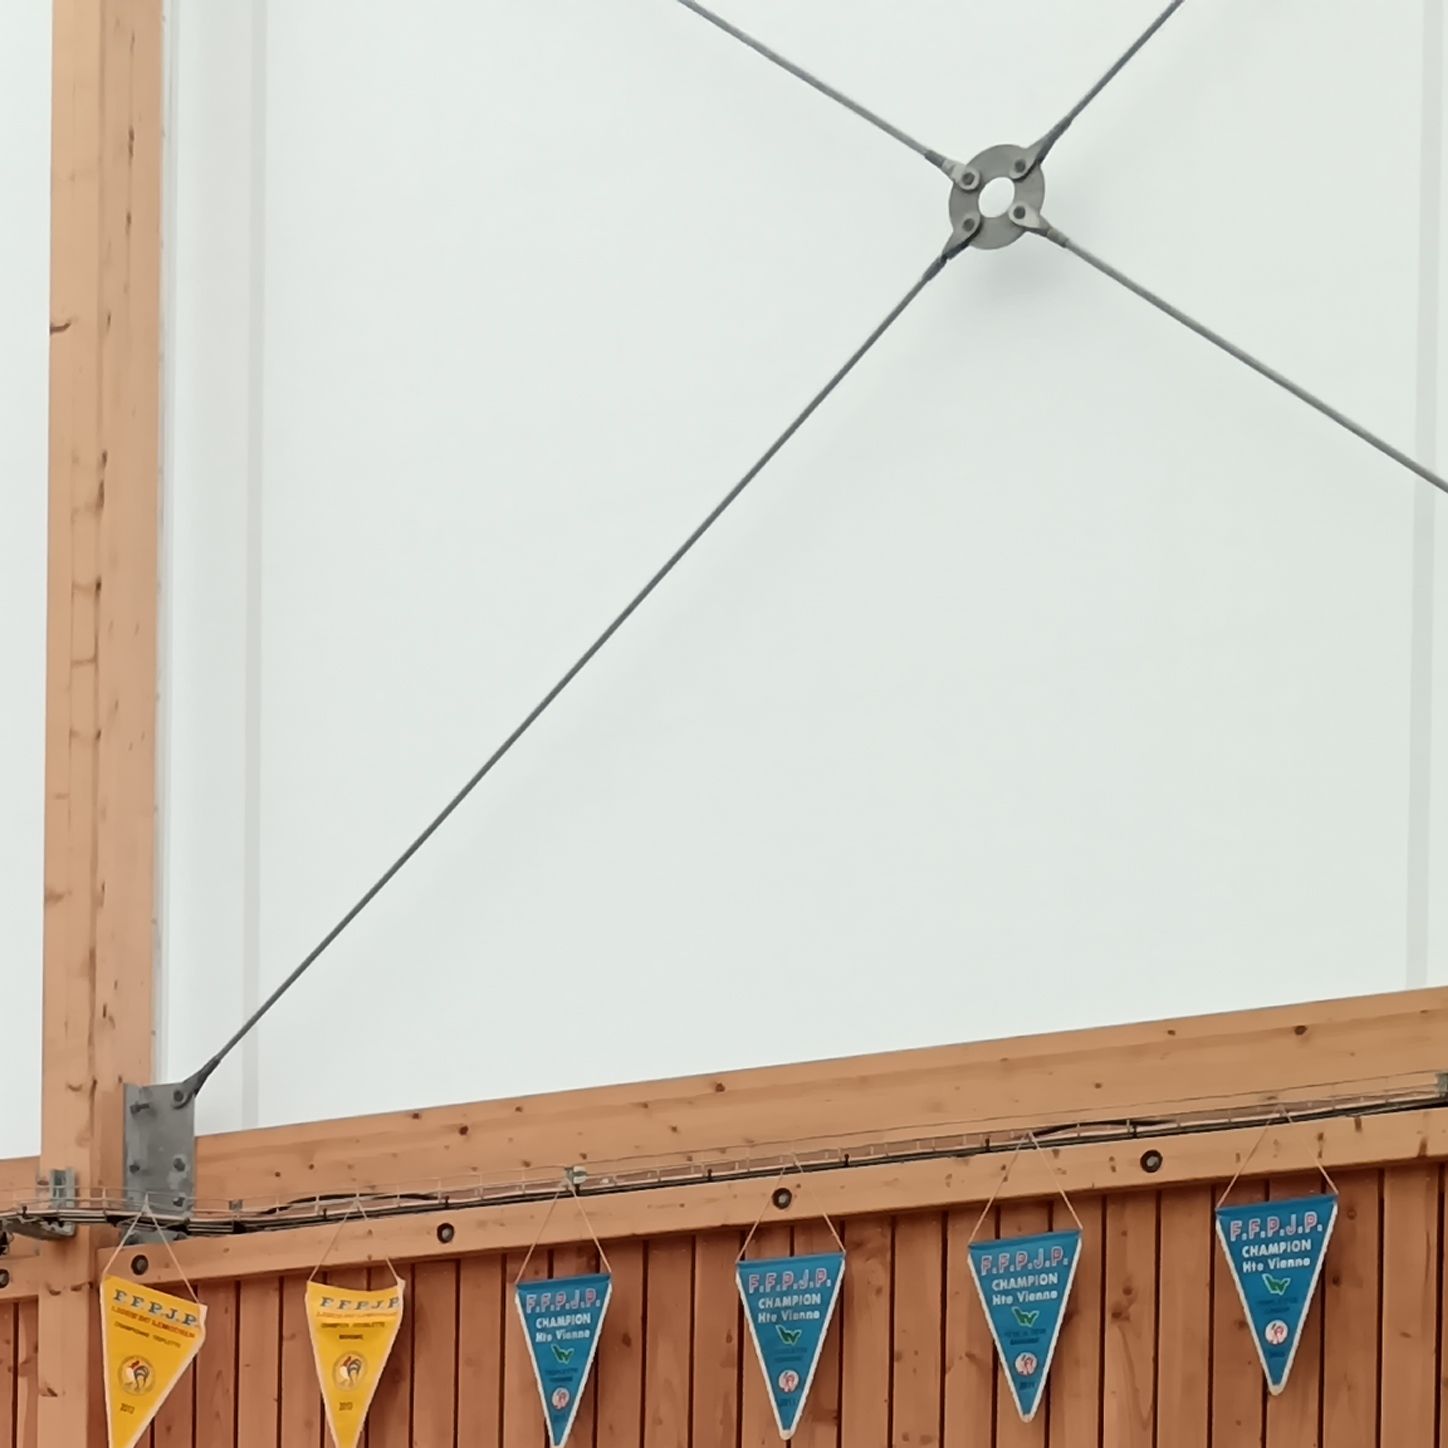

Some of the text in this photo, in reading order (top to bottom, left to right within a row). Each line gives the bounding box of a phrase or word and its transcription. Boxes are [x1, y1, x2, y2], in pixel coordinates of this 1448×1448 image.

[1230, 1211, 1323, 1242] F.F.P.J.P.
[1241, 1239, 1312, 1258] CHAMPION
[981, 1246, 1068, 1276] F.F.P.J.P.
[1268, 1257, 1311, 1270] Vienne
[748, 1267, 832, 1293] F.F.P.J.P.
[992, 1272, 1058, 1291] CHAMPION
[526, 1288, 600, 1314] F.F.P.J.P.
[758, 1293, 821, 1309] CHAMPION
[1017, 1290, 1058, 1303] Vienne
[536, 1313, 591, 1329] CHAMPION
